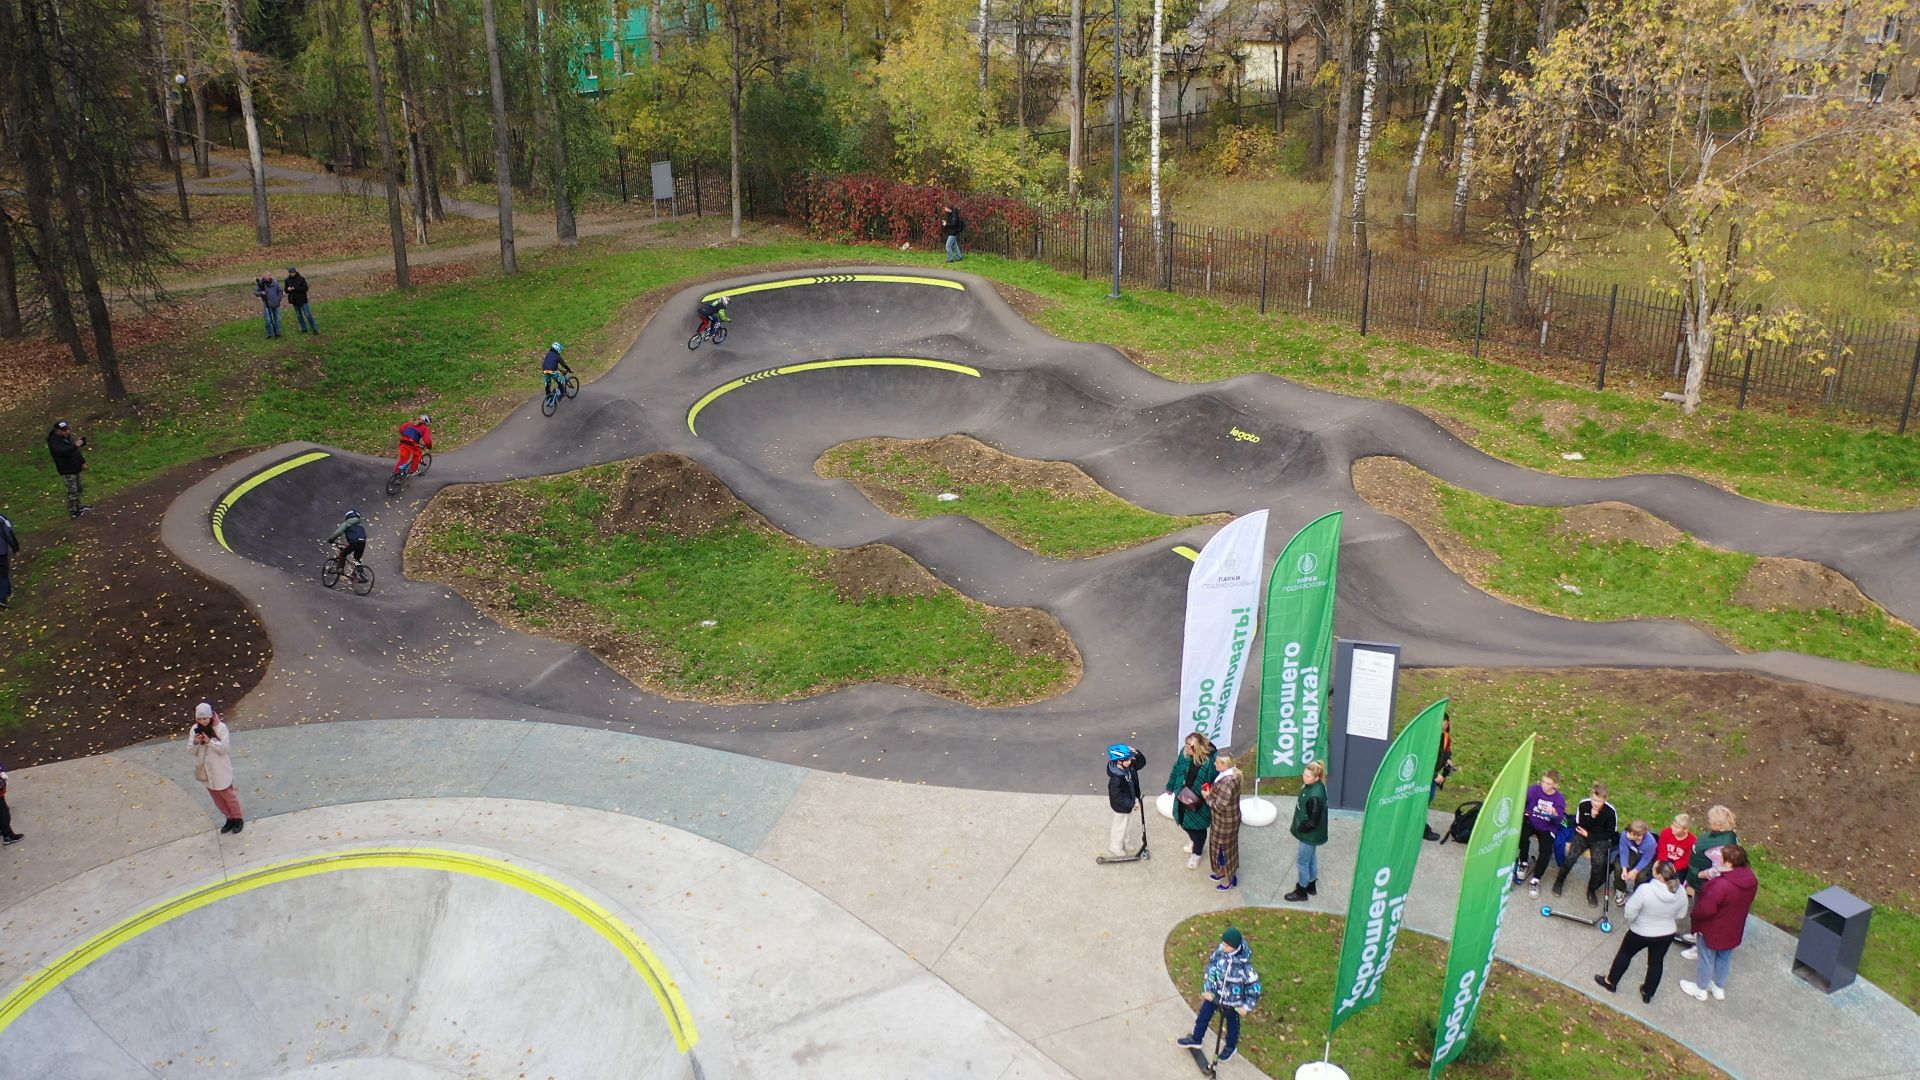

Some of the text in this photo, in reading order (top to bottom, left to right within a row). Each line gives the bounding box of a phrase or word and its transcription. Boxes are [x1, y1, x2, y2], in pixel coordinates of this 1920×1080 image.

[1229, 426, 1260, 443] legato
[1296, 575, 1318, 584] ПАРКИ
[1192, 677, 1217, 737] обро
[1272, 641, 1300, 767] Хорошего
[1300, 666, 1319, 765] отдыха!
[1337, 866, 1391, 1016] Хорошего
[1435, 969, 1476, 1063] Добро
